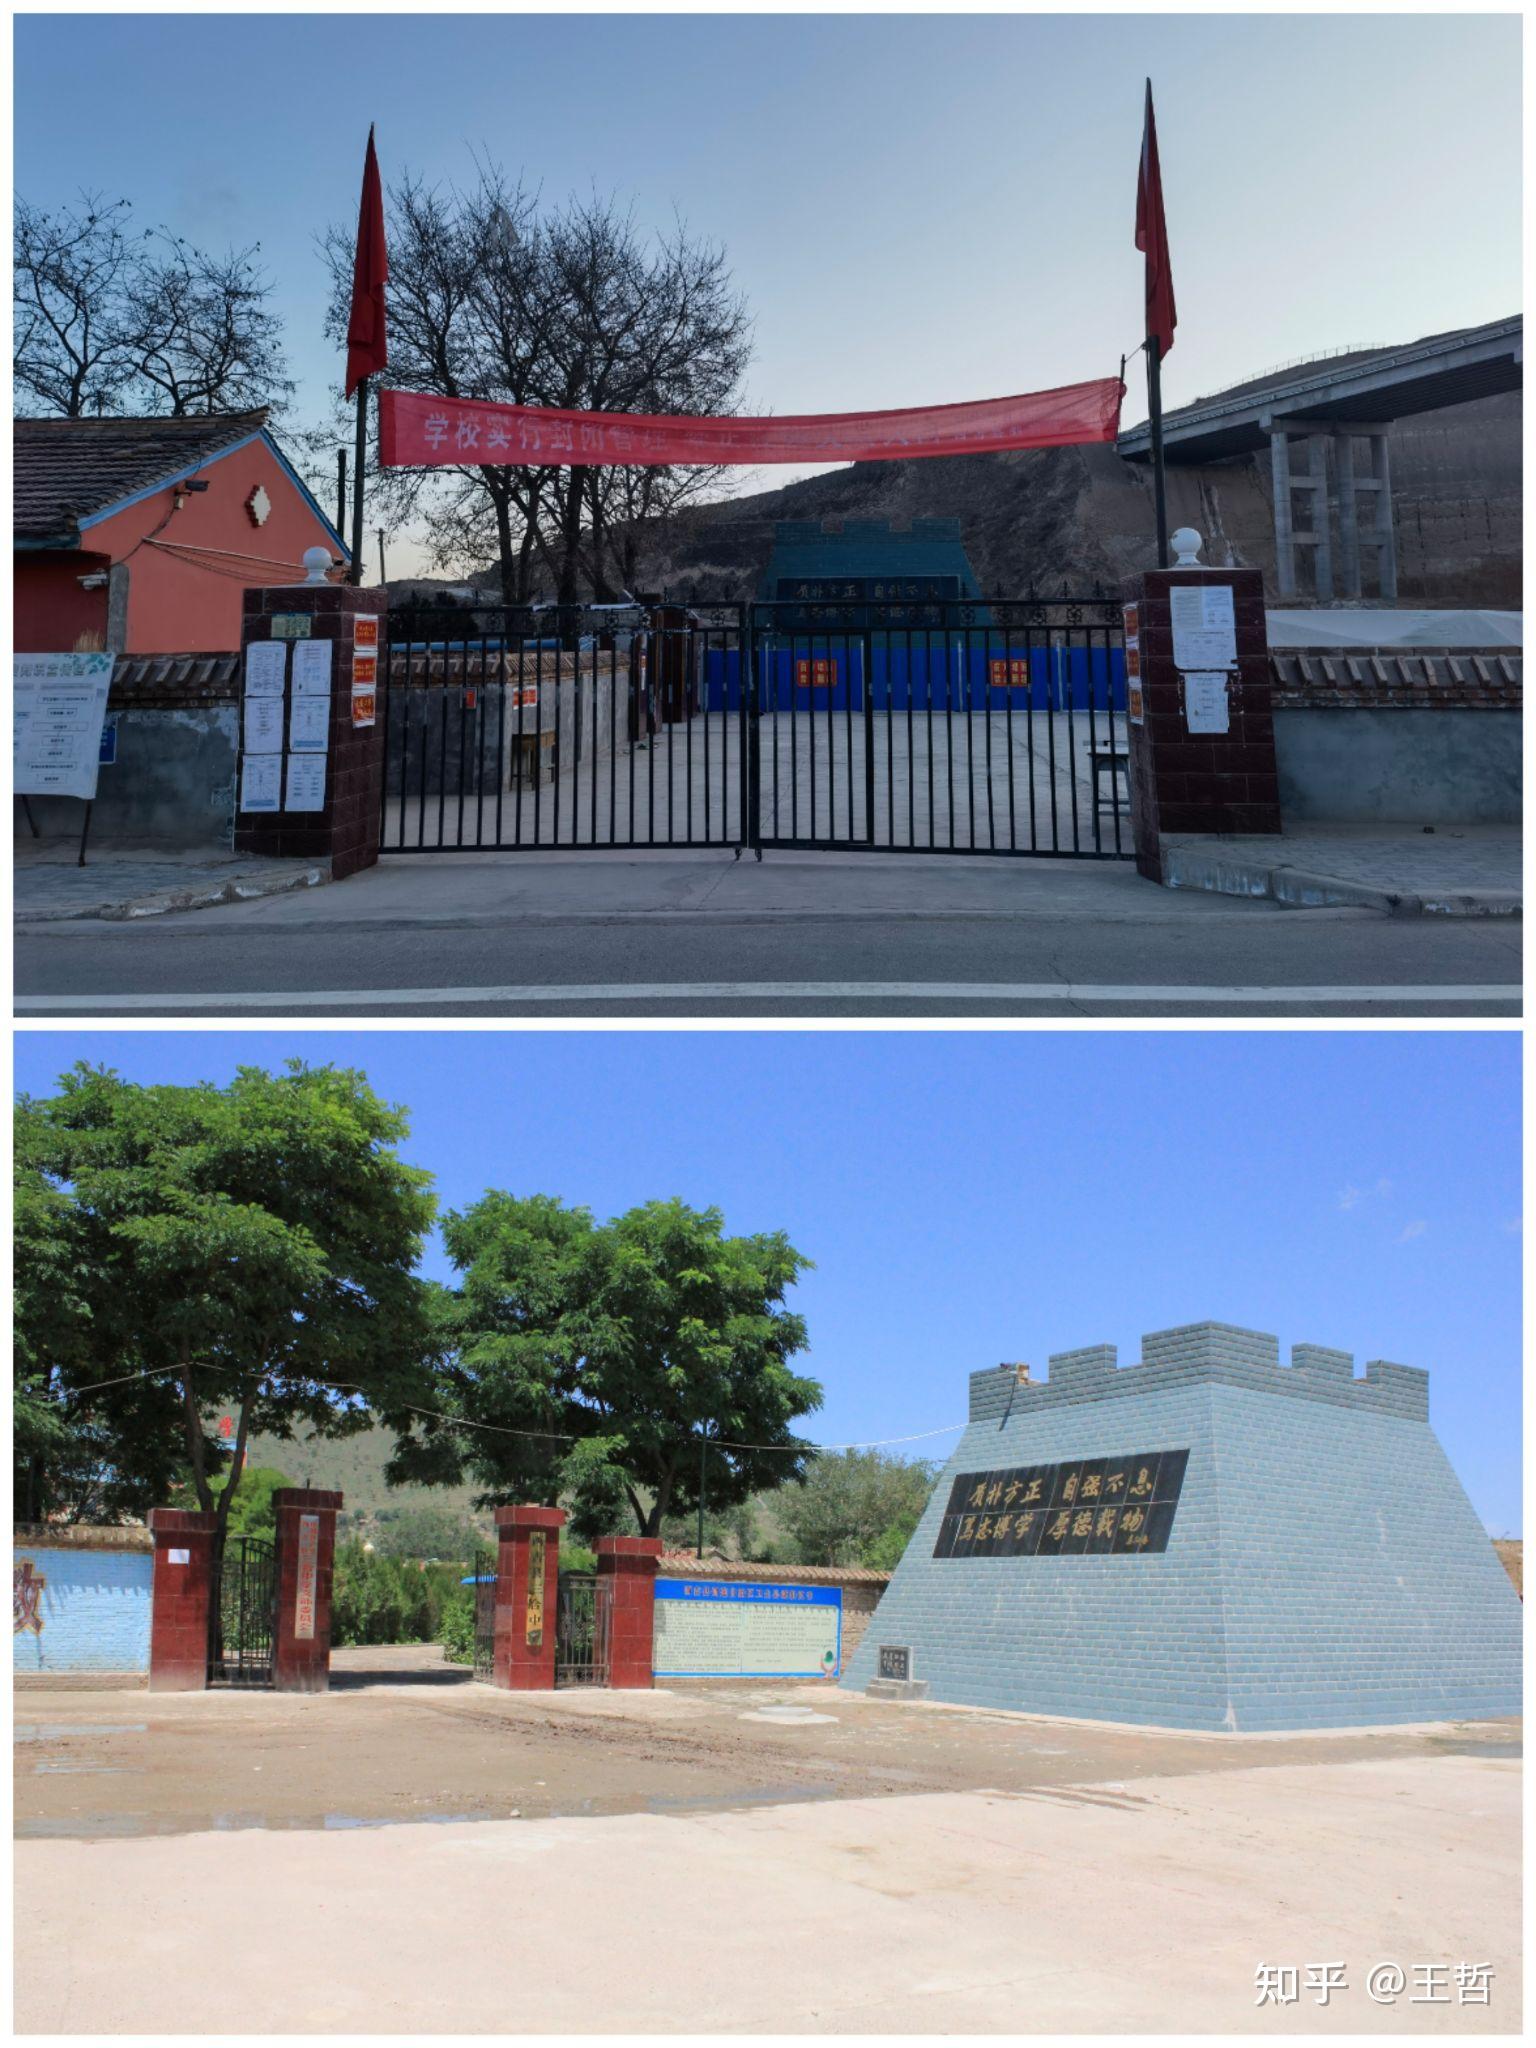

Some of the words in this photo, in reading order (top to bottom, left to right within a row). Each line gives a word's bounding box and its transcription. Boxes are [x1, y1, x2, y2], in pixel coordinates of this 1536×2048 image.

[968, 1479, 1043, 1507] 质朴方正
[1062, 1467, 1152, 1501] 自强不息
[1046, 1506, 1144, 1541] 厚德载物
